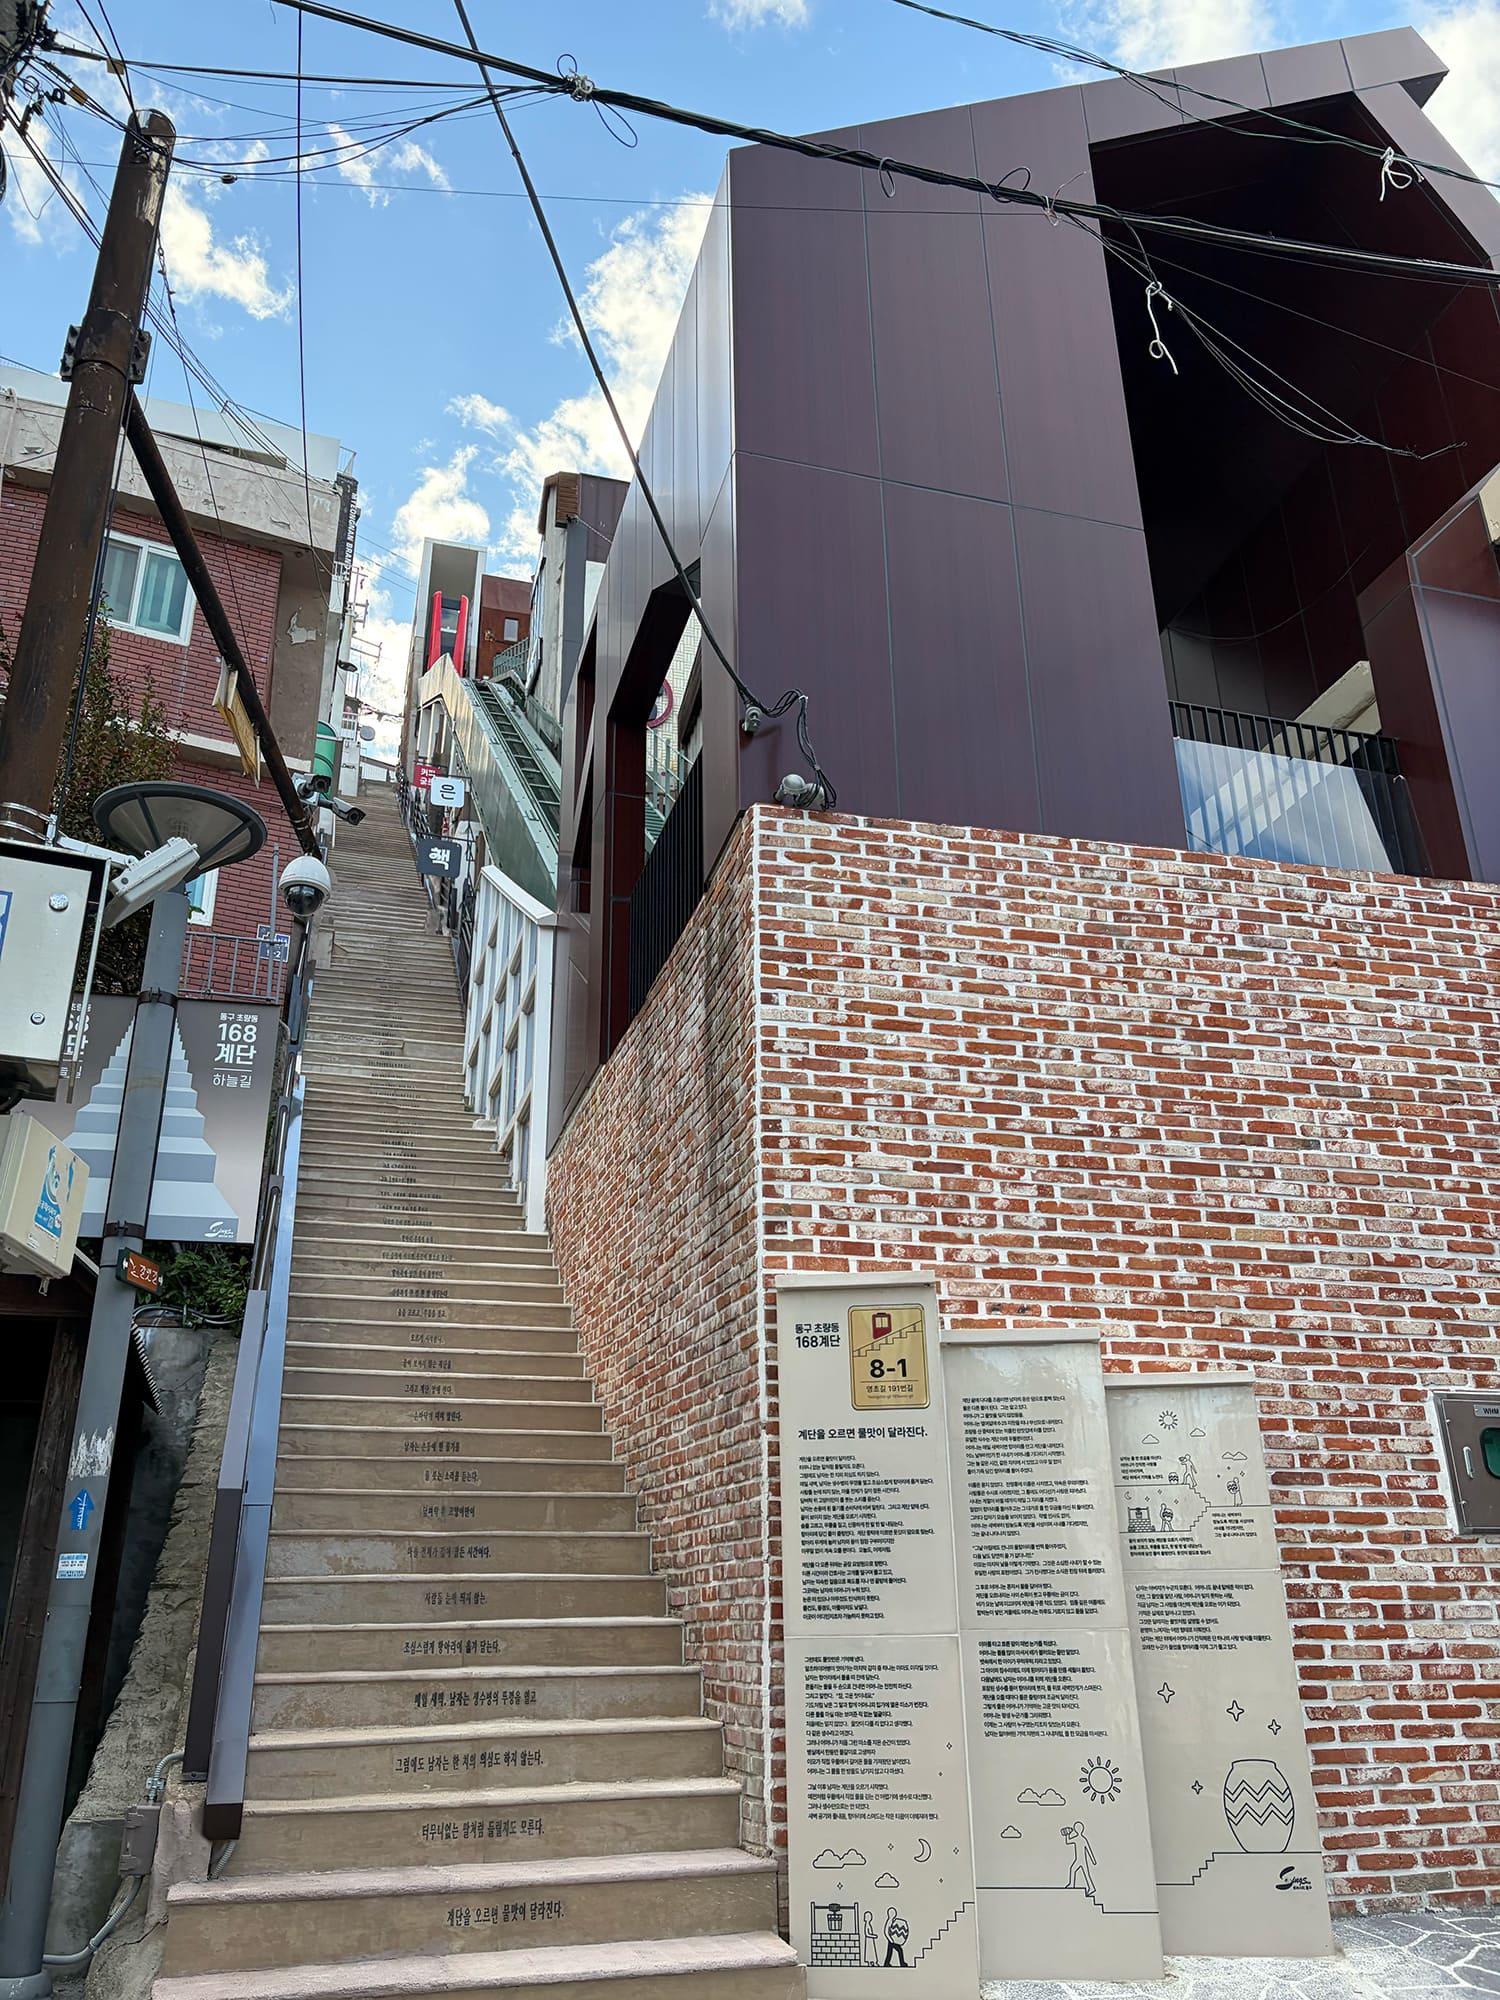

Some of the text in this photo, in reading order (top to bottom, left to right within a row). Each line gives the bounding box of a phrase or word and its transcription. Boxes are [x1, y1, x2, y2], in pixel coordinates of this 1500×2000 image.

[440, 784, 456, 800] 은
[429, 847, 451, 871] 책
[220, 1012, 235, 1021] 동구
[218, 1023, 257, 1043] 168
[214, 1043, 257, 1065] 계단
[212, 1073, 252, 1089] 하늘길
[795, 1322, 840, 1334] 동구 초량동
[795, 1335, 841, 1349] 168계단
[870, 1358, 907, 1379] 8-1
[798, 1426, 928, 1440] 계단을 오르면 물맛이 달라진다.
[395, 1749, 544, 1772] 그럼에도 남자는 한 치의 의심도 하지 않는다.
[422, 1817, 545, 1841] 터무니없는 말처럼 들릴지도 모른다.
[446, 1900, 566, 1927] 계단을 오르면 물맛이 달라진다.
